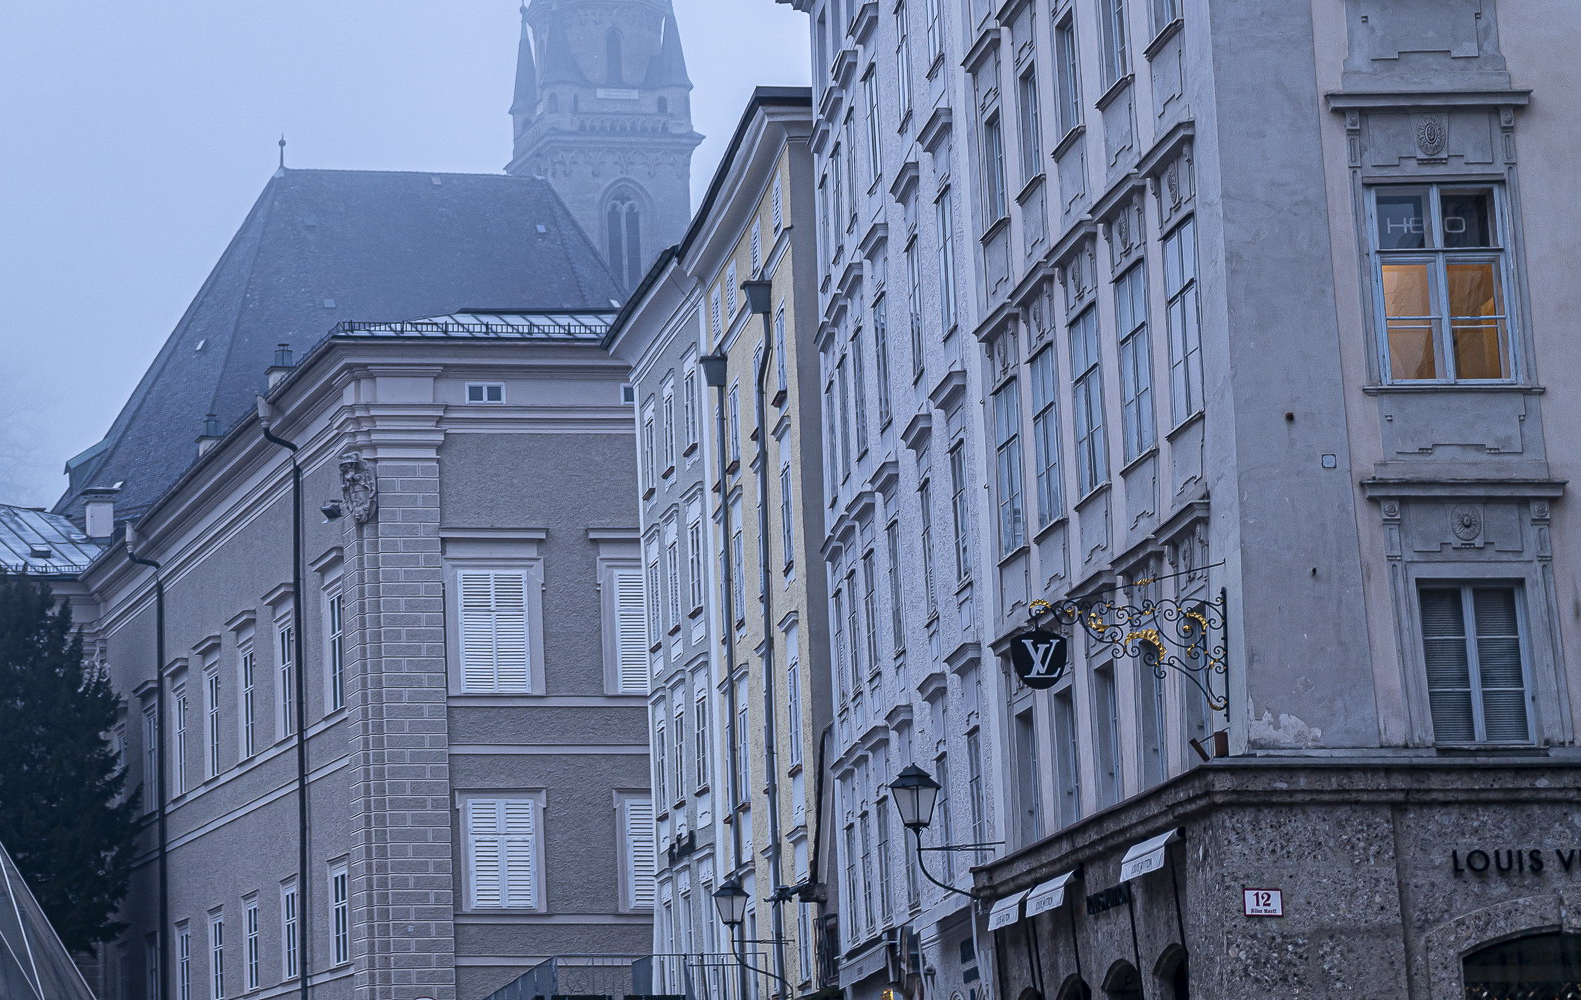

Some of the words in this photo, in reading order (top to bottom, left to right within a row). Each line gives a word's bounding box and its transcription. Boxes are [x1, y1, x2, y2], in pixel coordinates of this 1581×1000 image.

[1452, 849, 1544, 873] LOUIS
[1555, 849, 1581, 873] V
[1252, 891, 1272, 907] 12
